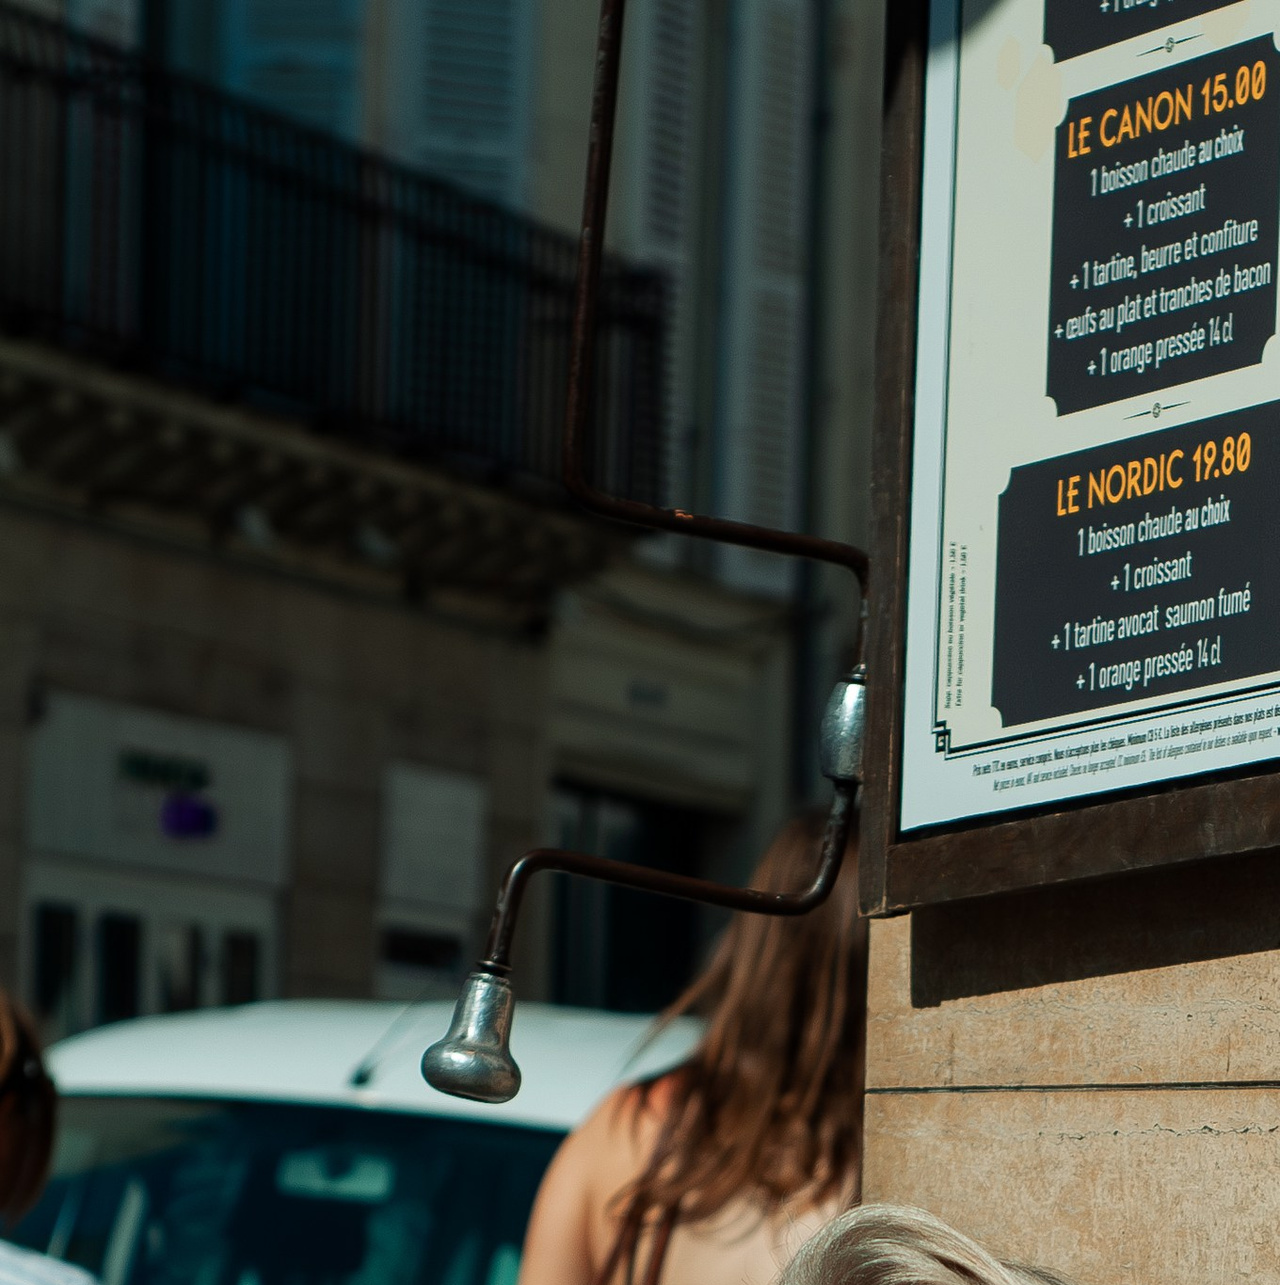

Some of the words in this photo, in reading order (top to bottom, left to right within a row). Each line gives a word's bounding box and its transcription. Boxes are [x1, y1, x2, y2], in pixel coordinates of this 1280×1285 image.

[1068, 117, 1092, 158] LE
[1100, 84, 1193, 147] CANON
[1201, 61, 1266, 115] 15.00
[1091, 169, 1097, 196] 1
[1101, 160, 1148, 193] boisson
[1151, 140, 1196, 178] chaude
[1198, 140, 1213, 164] au
[1214, 125, 1244, 159] choix
[1137, 200, 1143, 228] 1
[1147, 183, 1206, 225] croissant
[1083, 262, 1089, 289] 1
[1093, 253, 1137, 286] tartine,
[1141, 242, 1182, 273] beurre
[1184, 232, 1198, 260] et
[1201, 219, 1258, 255] confiture
[1099, 307, 1114, 330] au
[1116, 294, 1142, 333] plat
[1144, 290, 1157, 318] et
[1159, 277, 1213, 313] tranches
[1215, 268, 1231, 298] de
[1233, 262, 1271, 293] bacon
[1100, 348, 1107, 375] 1
[1111, 342, 1153, 373] orange
[1156, 322, 1205, 368] pressée
[1209, 316, 1220, 346] 14
[1222, 313, 1233, 343] cl
[1057, 475, 1080, 516] LE
[1088, 449, 1184, 508] NORDIC
[1193, 432, 1251, 482] 19.80
[1078, 528, 1084, 556] 1
[1088, 523, 1135, 554] boisson
[1138, 506, 1182, 542] chaude
[1185, 508, 1199, 531] au
[1201, 496, 1230, 527] choix
[1124, 563, 1130, 591] 1
[1134, 551, 1192, 589] croissant
[1064, 623, 1070, 650] 1
[1074, 616, 1115, 648] tartine
[1118, 605, 1159, 639] avocat
[1165, 598, 1214, 628] saumon
[1218, 582, 1250, 617] fumé
[1089, 663, 1095, 690] 1
[1099, 660, 1141, 690] orange
[1143, 643, 1193, 687] pressée
[1197, 638, 1208, 668] 14
[1211, 635, 1221, 665] cl
